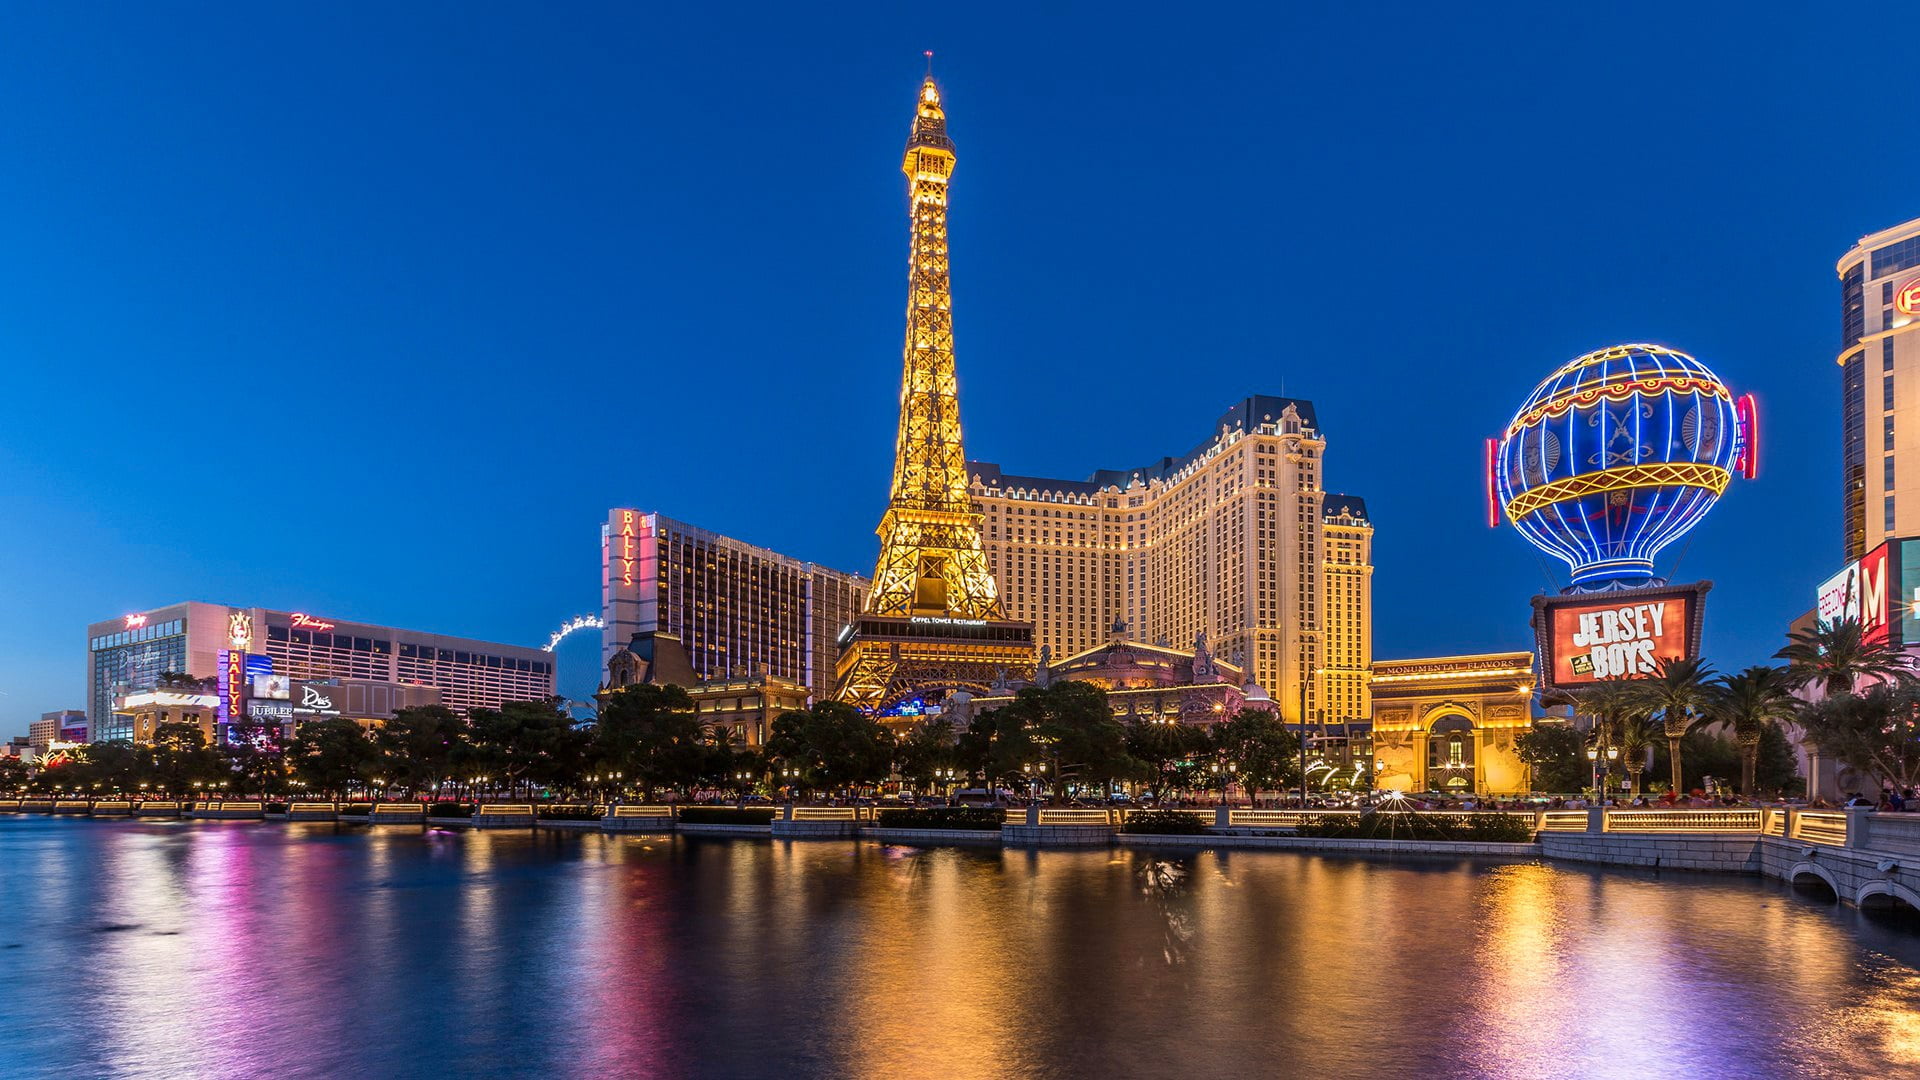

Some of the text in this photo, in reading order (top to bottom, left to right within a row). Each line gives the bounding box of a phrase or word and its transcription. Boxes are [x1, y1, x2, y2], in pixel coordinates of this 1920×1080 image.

[621, 511, 634, 586] BALLYS
[1862, 556, 1886, 633] M
[911, 616, 931, 624] EIFFEL
[932, 617, 952, 625] TOWER
[1573, 602, 1665, 647] JERSEY
[1386, 660, 1515, 675] MONUMENTAL FLAVORS
[1591, 639, 1657, 679] BOYS
[228, 652, 240, 716] BALLYS
